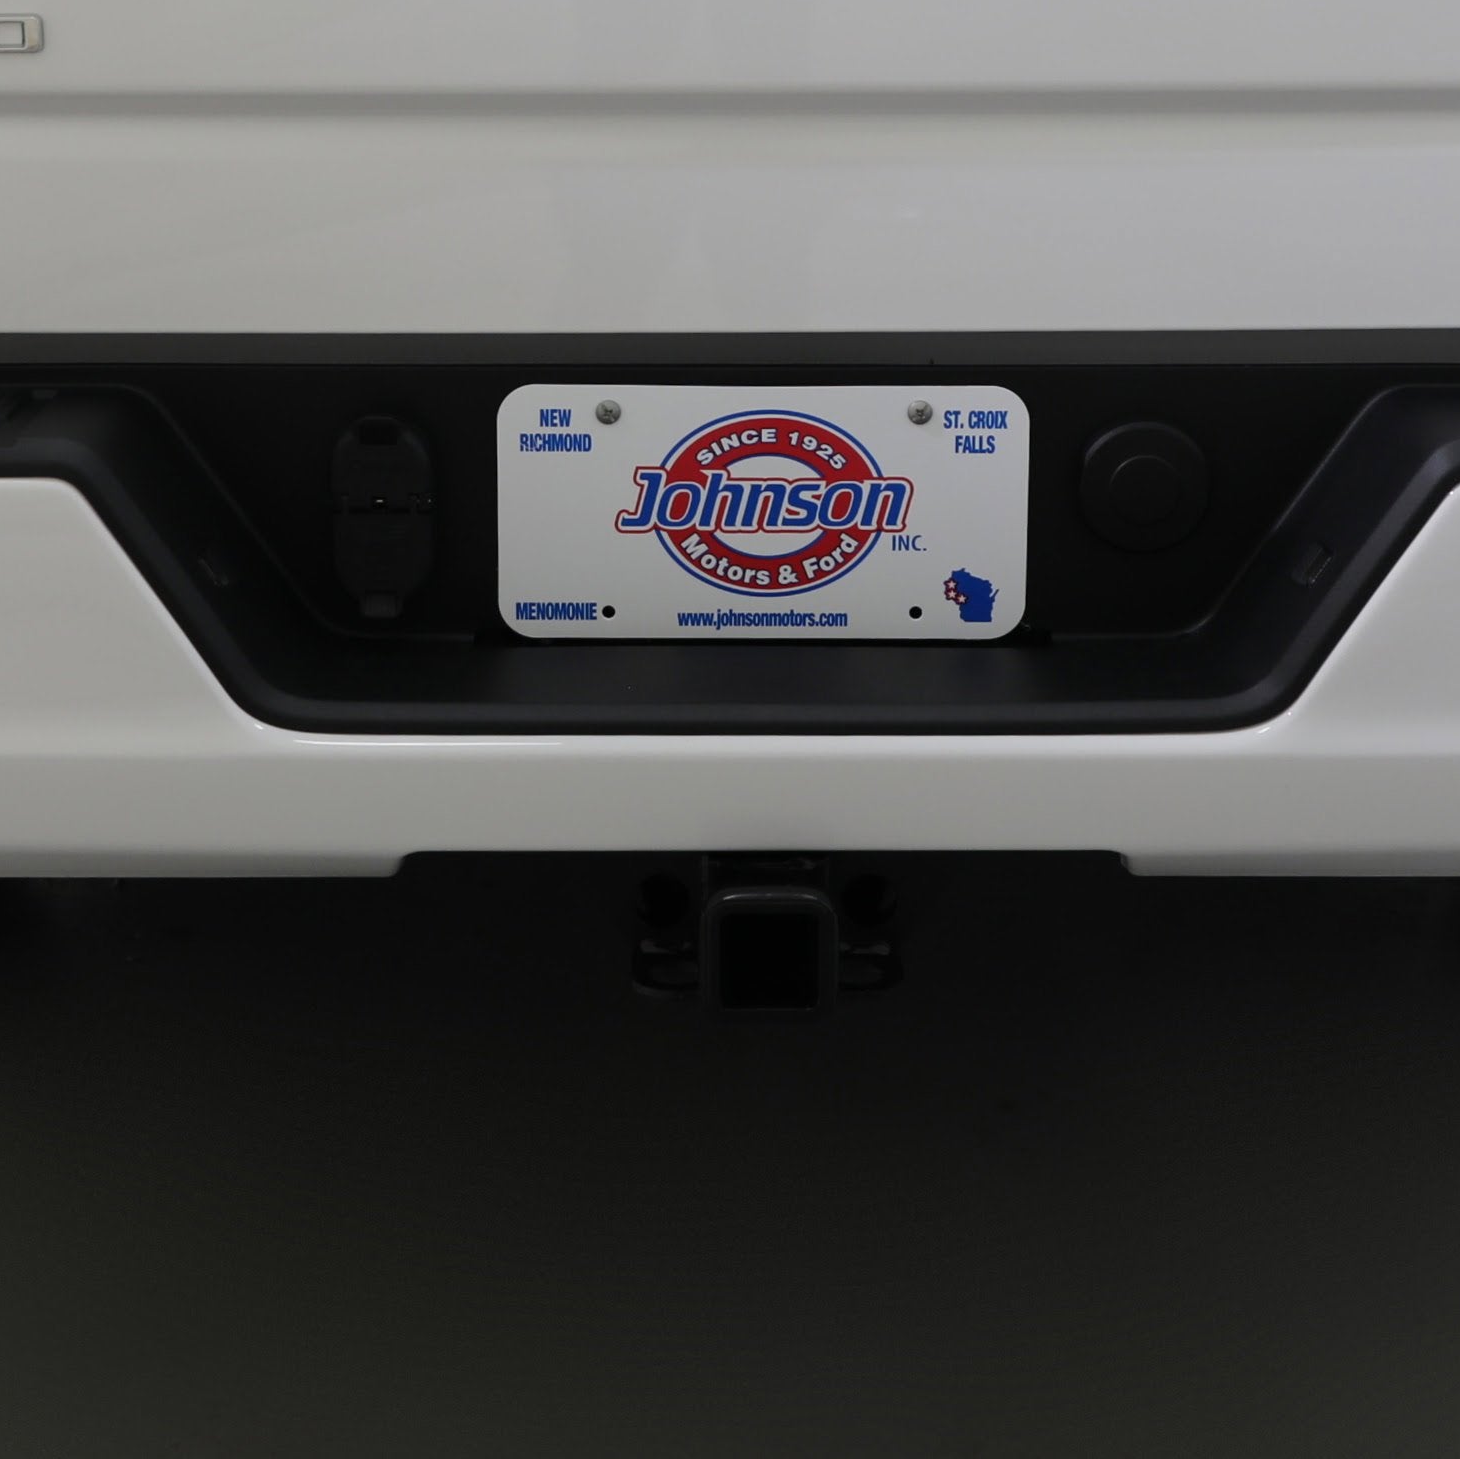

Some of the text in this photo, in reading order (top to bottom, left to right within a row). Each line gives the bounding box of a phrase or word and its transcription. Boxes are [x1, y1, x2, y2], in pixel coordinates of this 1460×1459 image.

[539, 408, 572, 428] NEW
[943, 410, 1009, 430] ST. CROIX
[519, 433, 592, 453] RICHMOND
[696, 427, 847, 471] SINCE 1925
[954, 434, 996, 454] FALLS
[618, 469, 911, 530] Johnson
[891, 534, 928, 552] INC.
[679, 532, 860, 586] Motors & Ford
[515, 601, 598, 621] MENOMONIE
[677, 608, 849, 631] www.johnsonmotors.com
